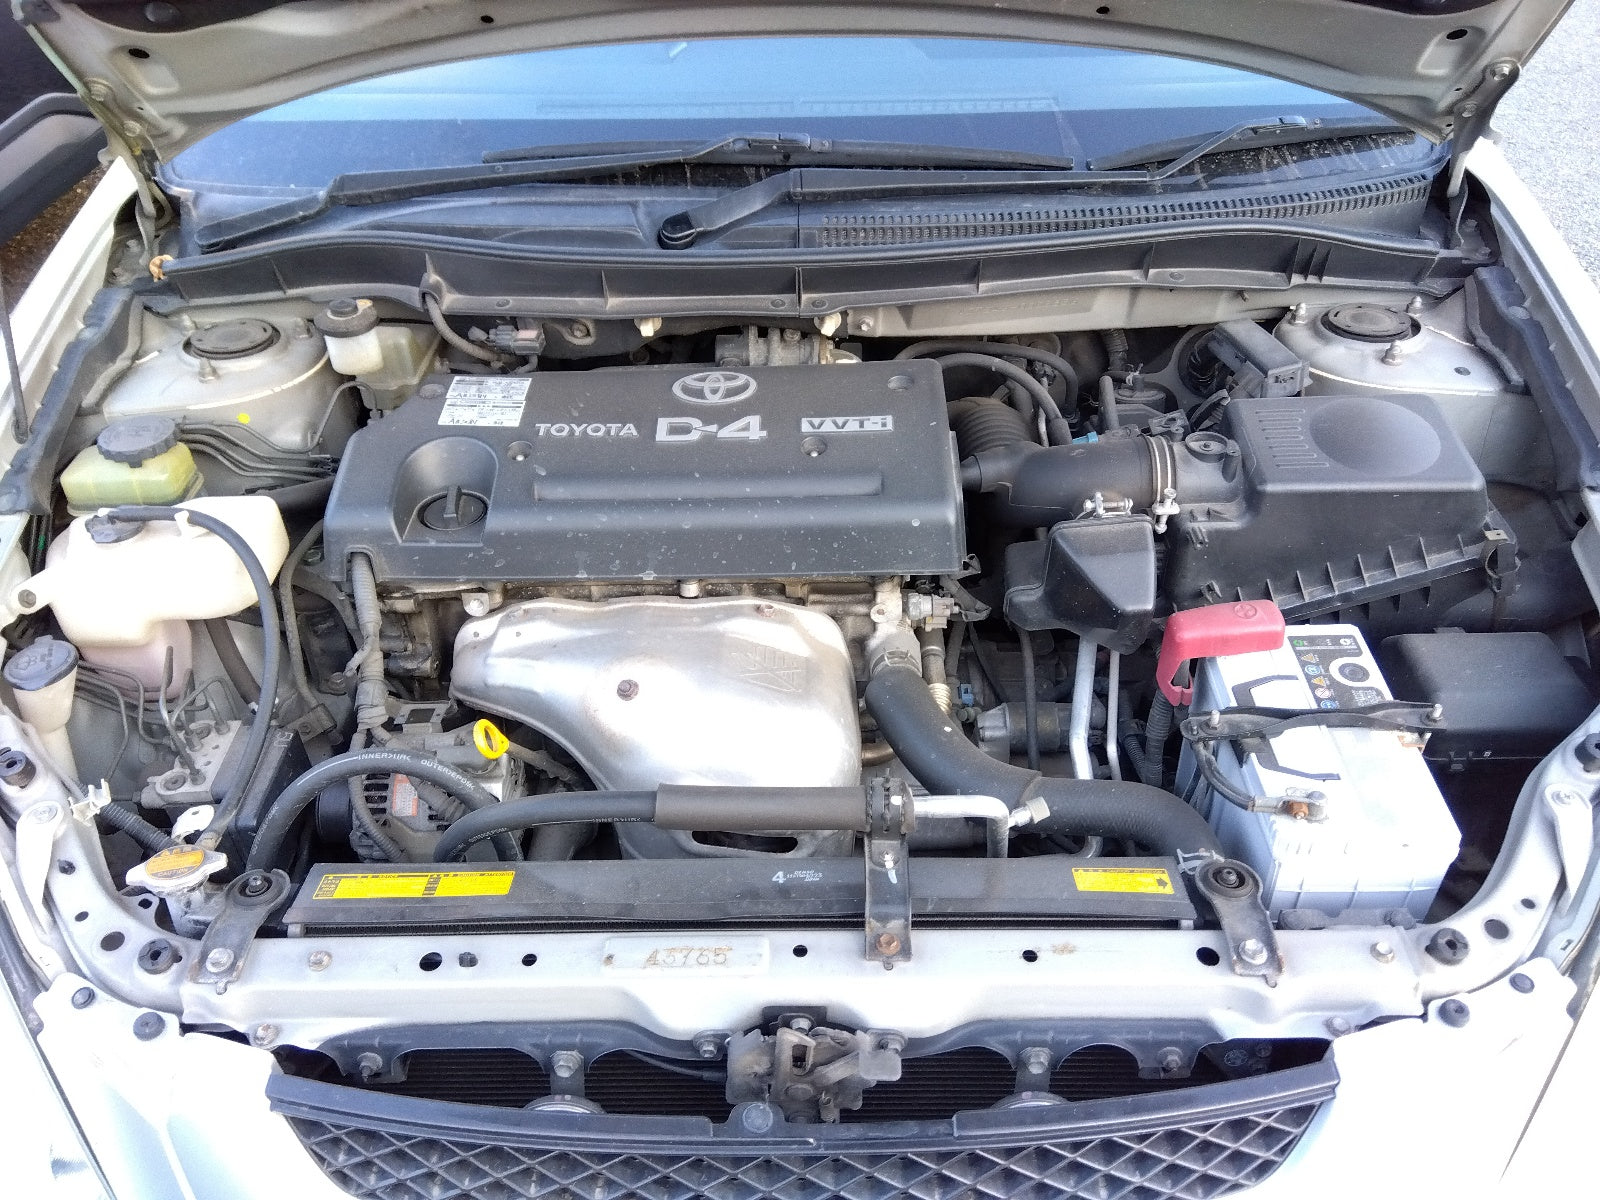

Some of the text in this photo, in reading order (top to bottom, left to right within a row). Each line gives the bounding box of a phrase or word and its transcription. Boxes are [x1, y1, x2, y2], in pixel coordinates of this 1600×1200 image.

[535, 414, 768, 443] TOYOTA D-4
[804, 417, 889, 430] VVT-i
[771, 871, 787, 883] 4
